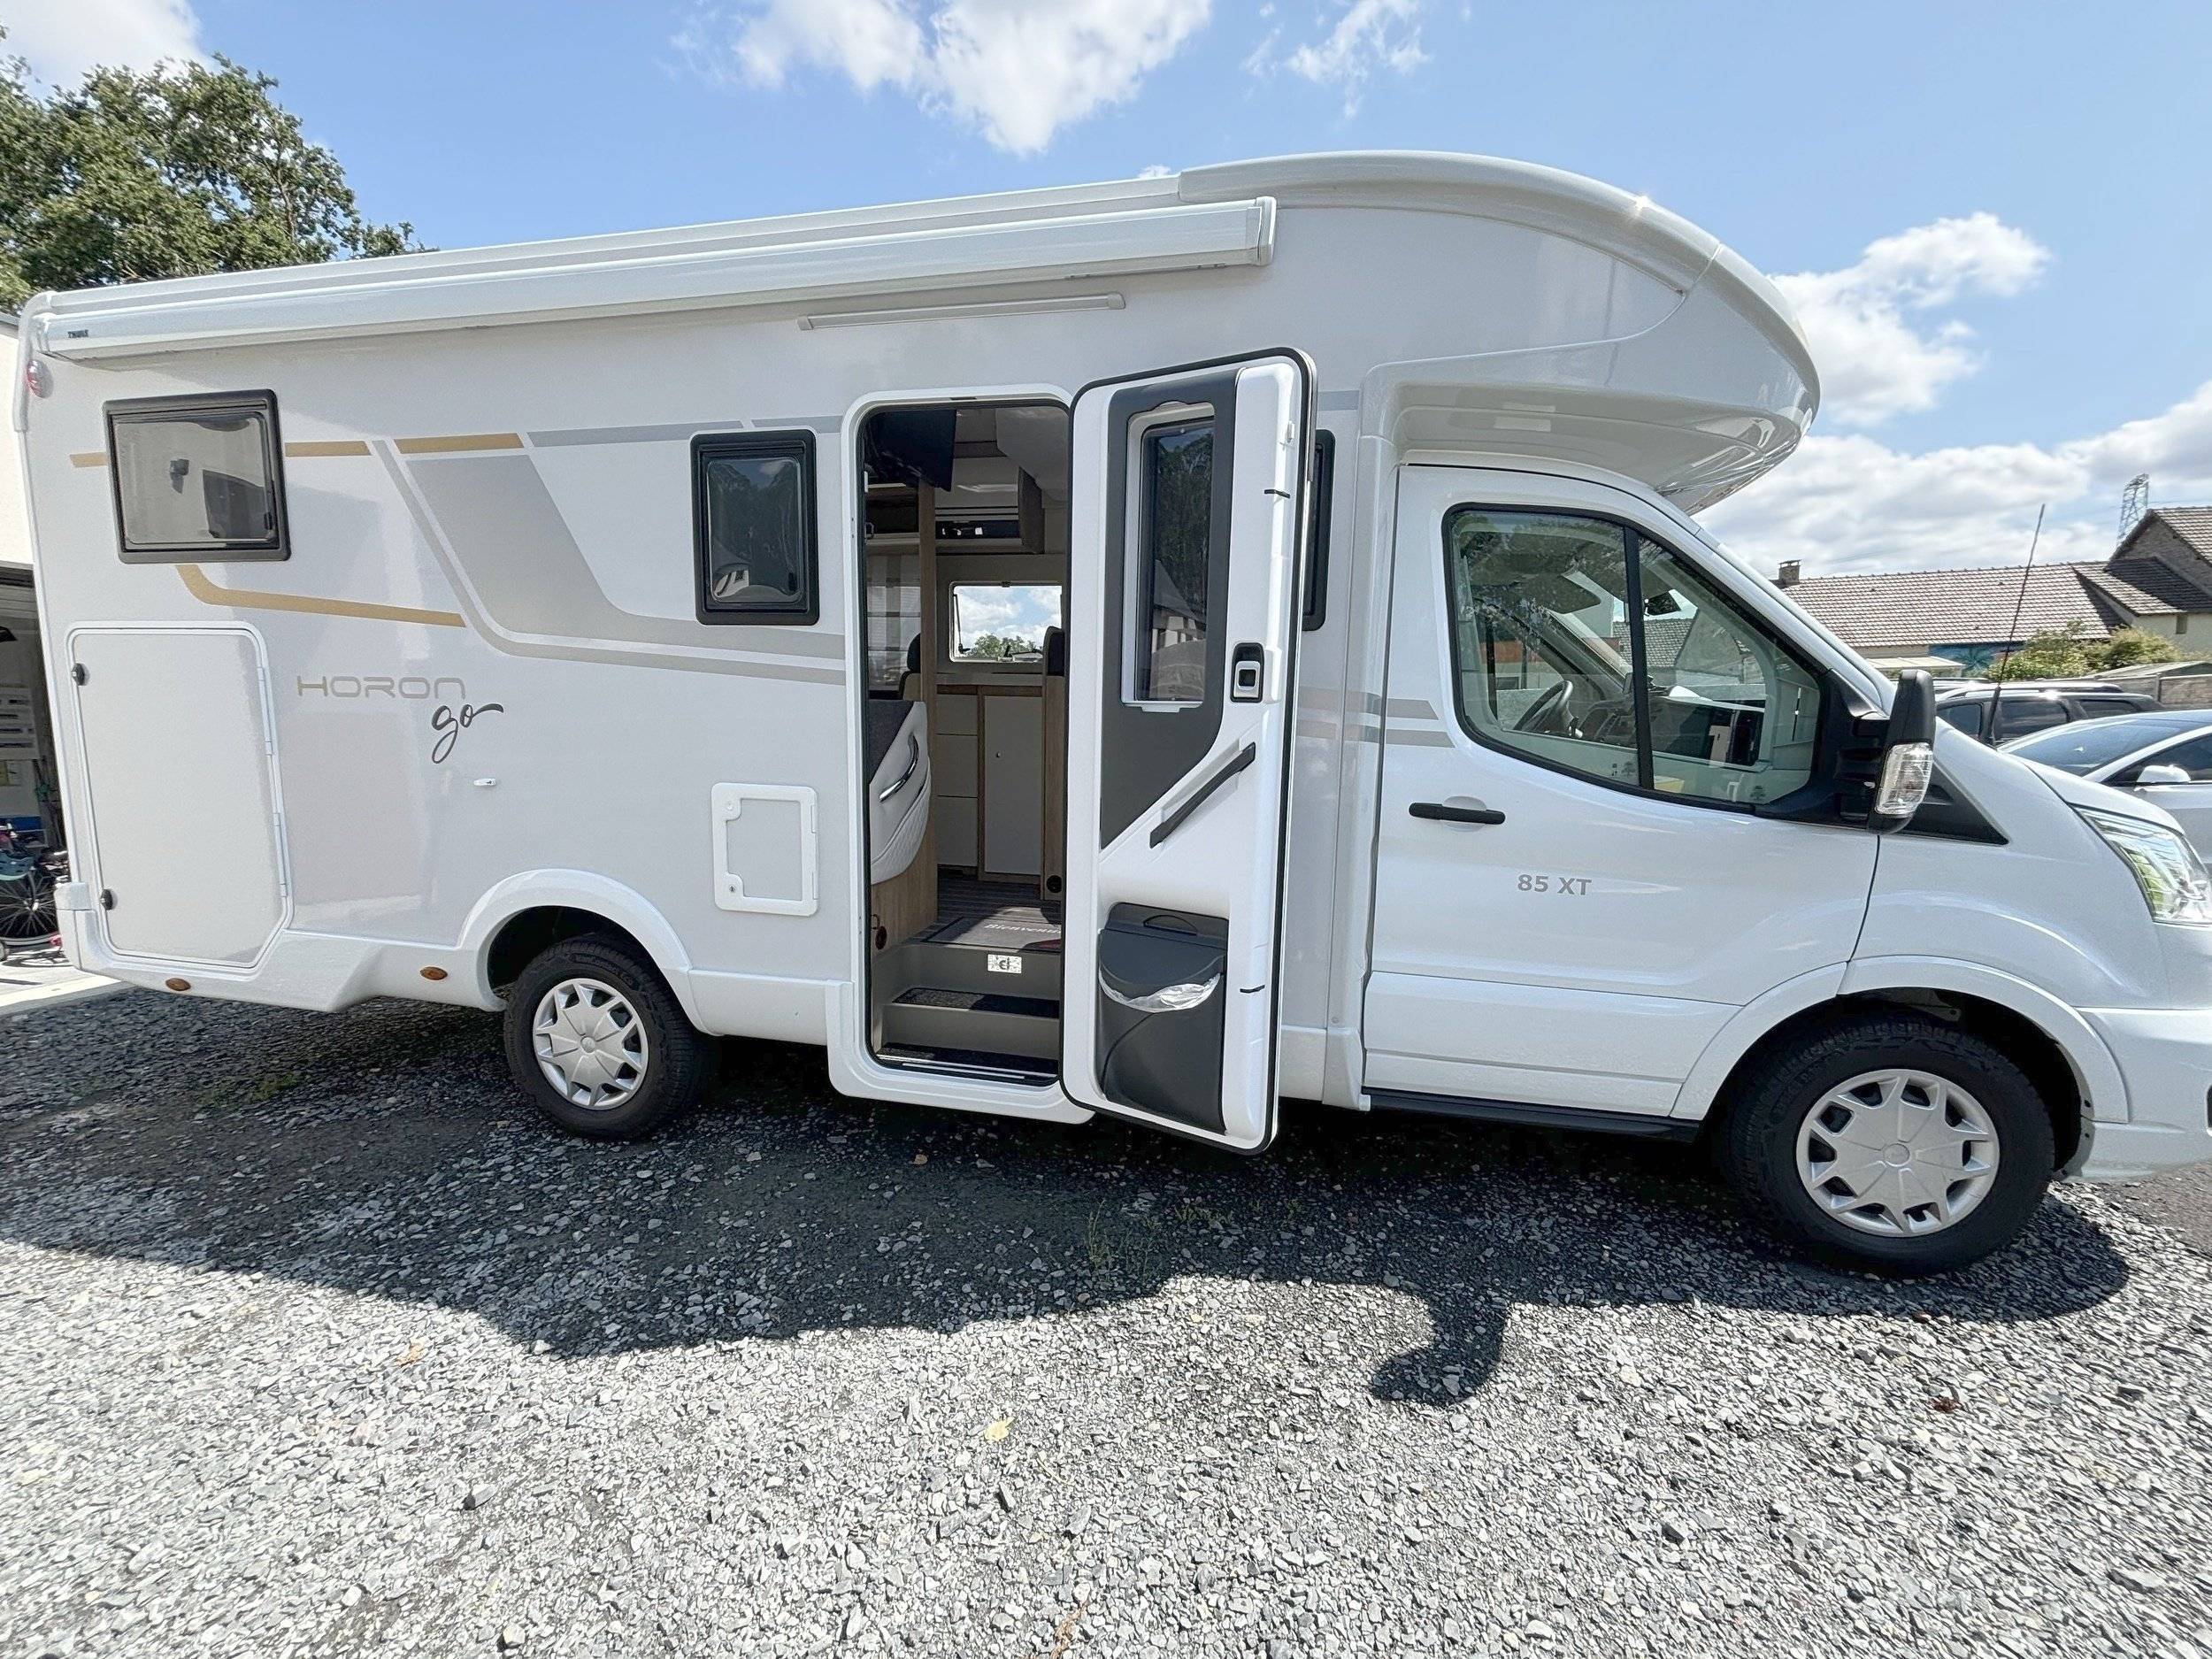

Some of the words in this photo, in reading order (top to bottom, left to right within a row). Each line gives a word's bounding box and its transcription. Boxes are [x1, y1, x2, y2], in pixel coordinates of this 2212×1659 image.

[431, 703, 504, 764] go
[1517, 873, 1549, 893] 85
[1557, 877, 1593, 895] XT
